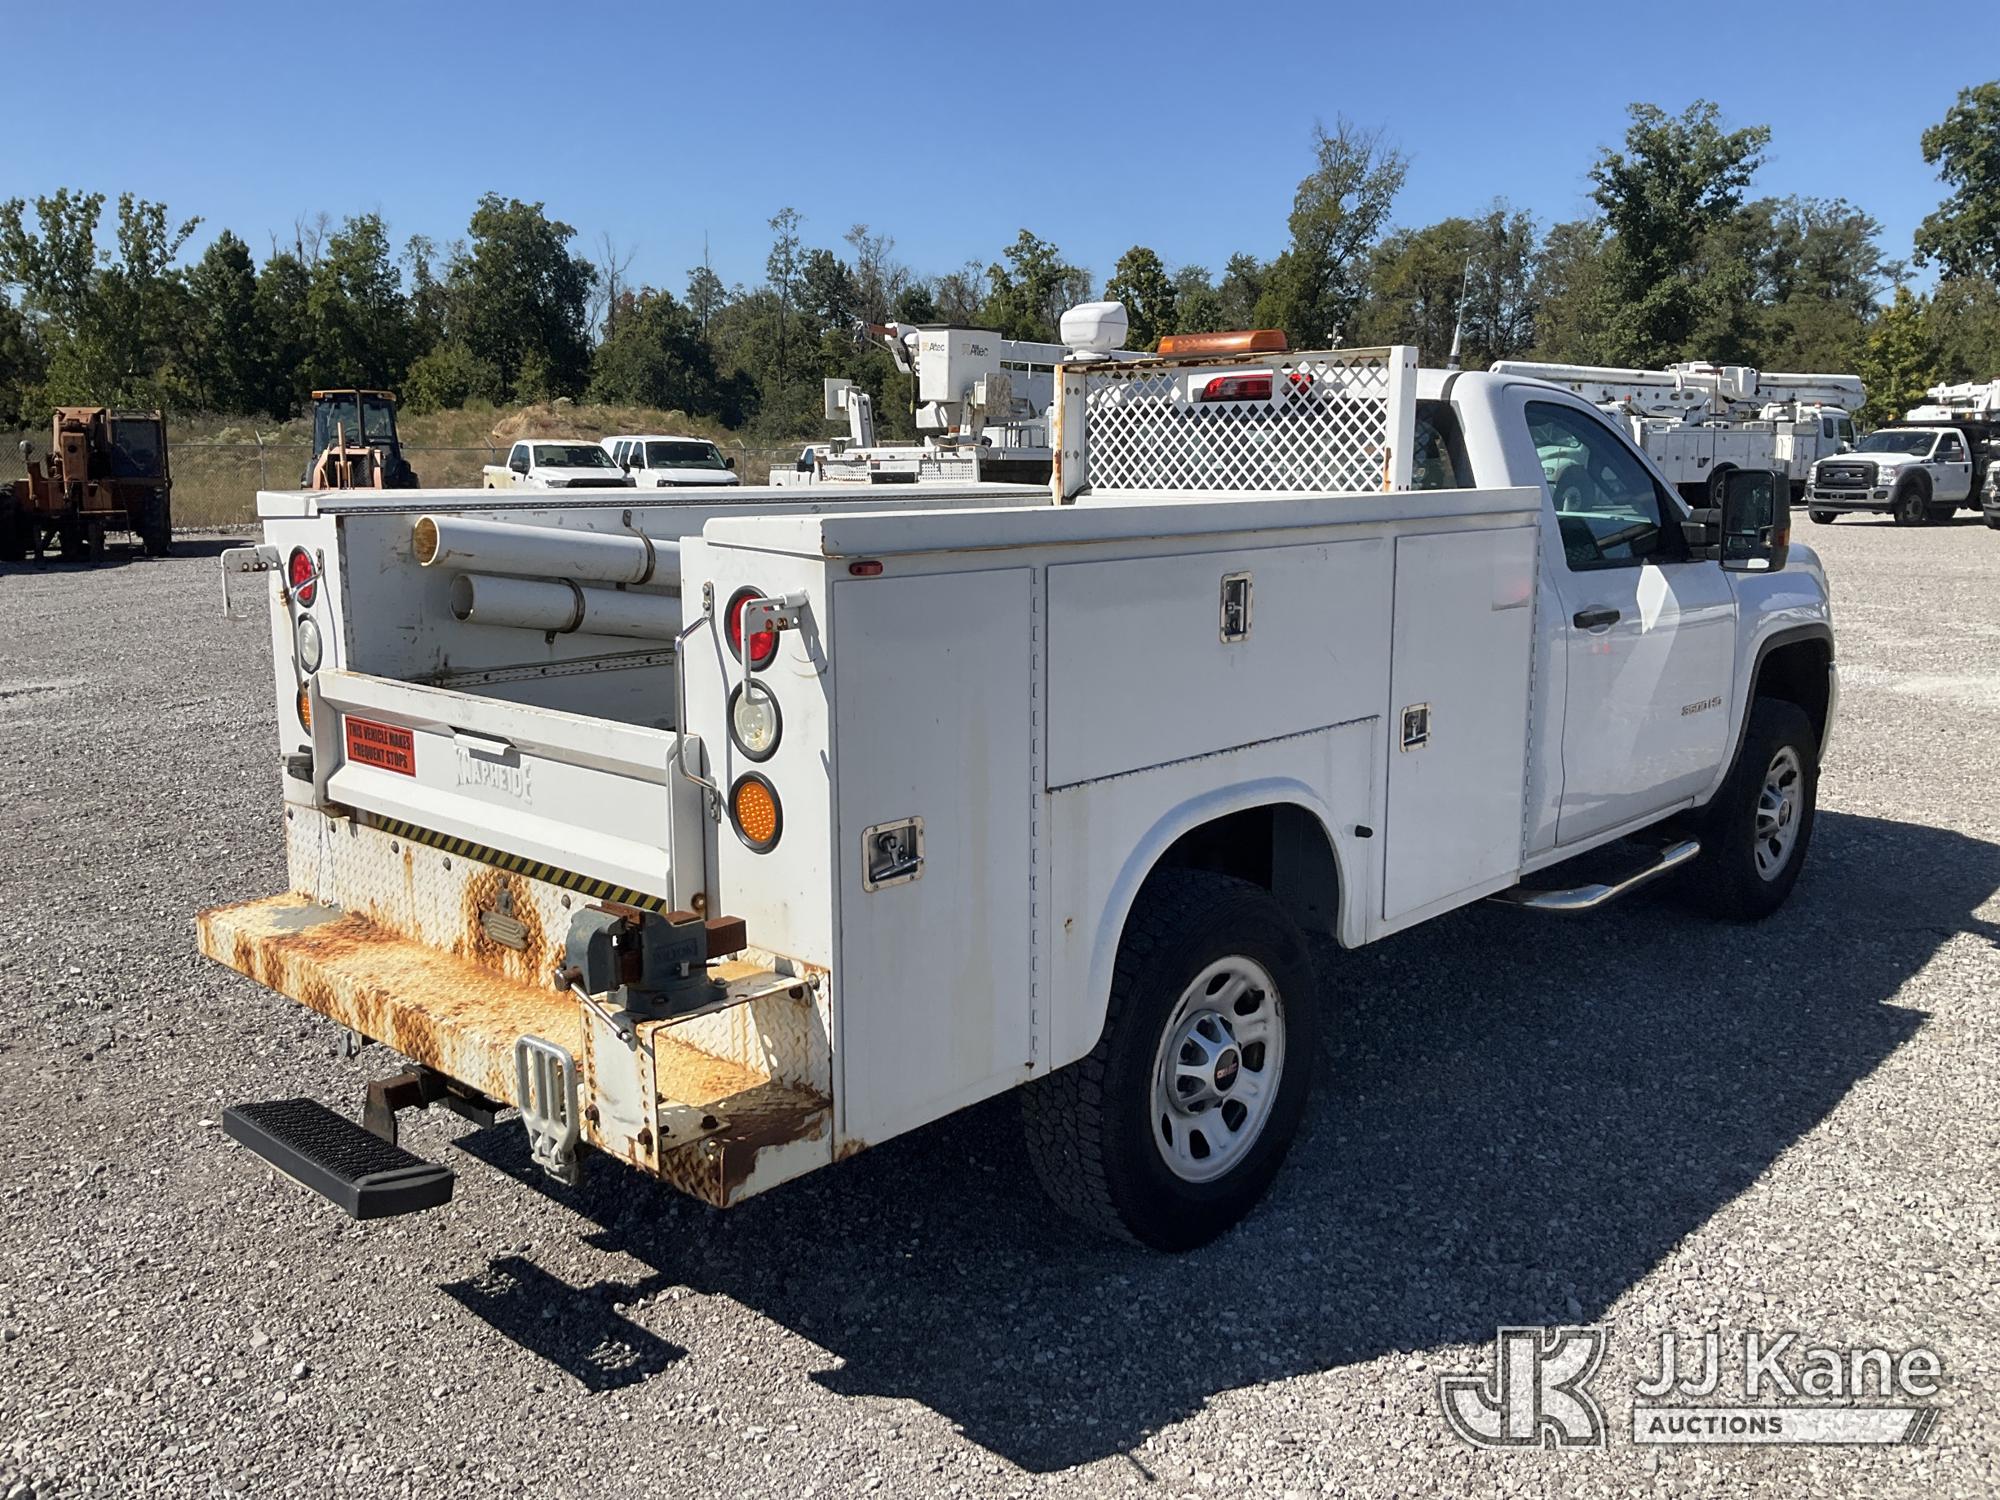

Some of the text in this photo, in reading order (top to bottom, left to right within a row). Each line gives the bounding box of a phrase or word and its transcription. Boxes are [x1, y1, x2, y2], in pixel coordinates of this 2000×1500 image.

[349, 722, 410, 750] THIS VEHICLE MAKES
[353, 742, 408, 769] FREQUENT STOPS
